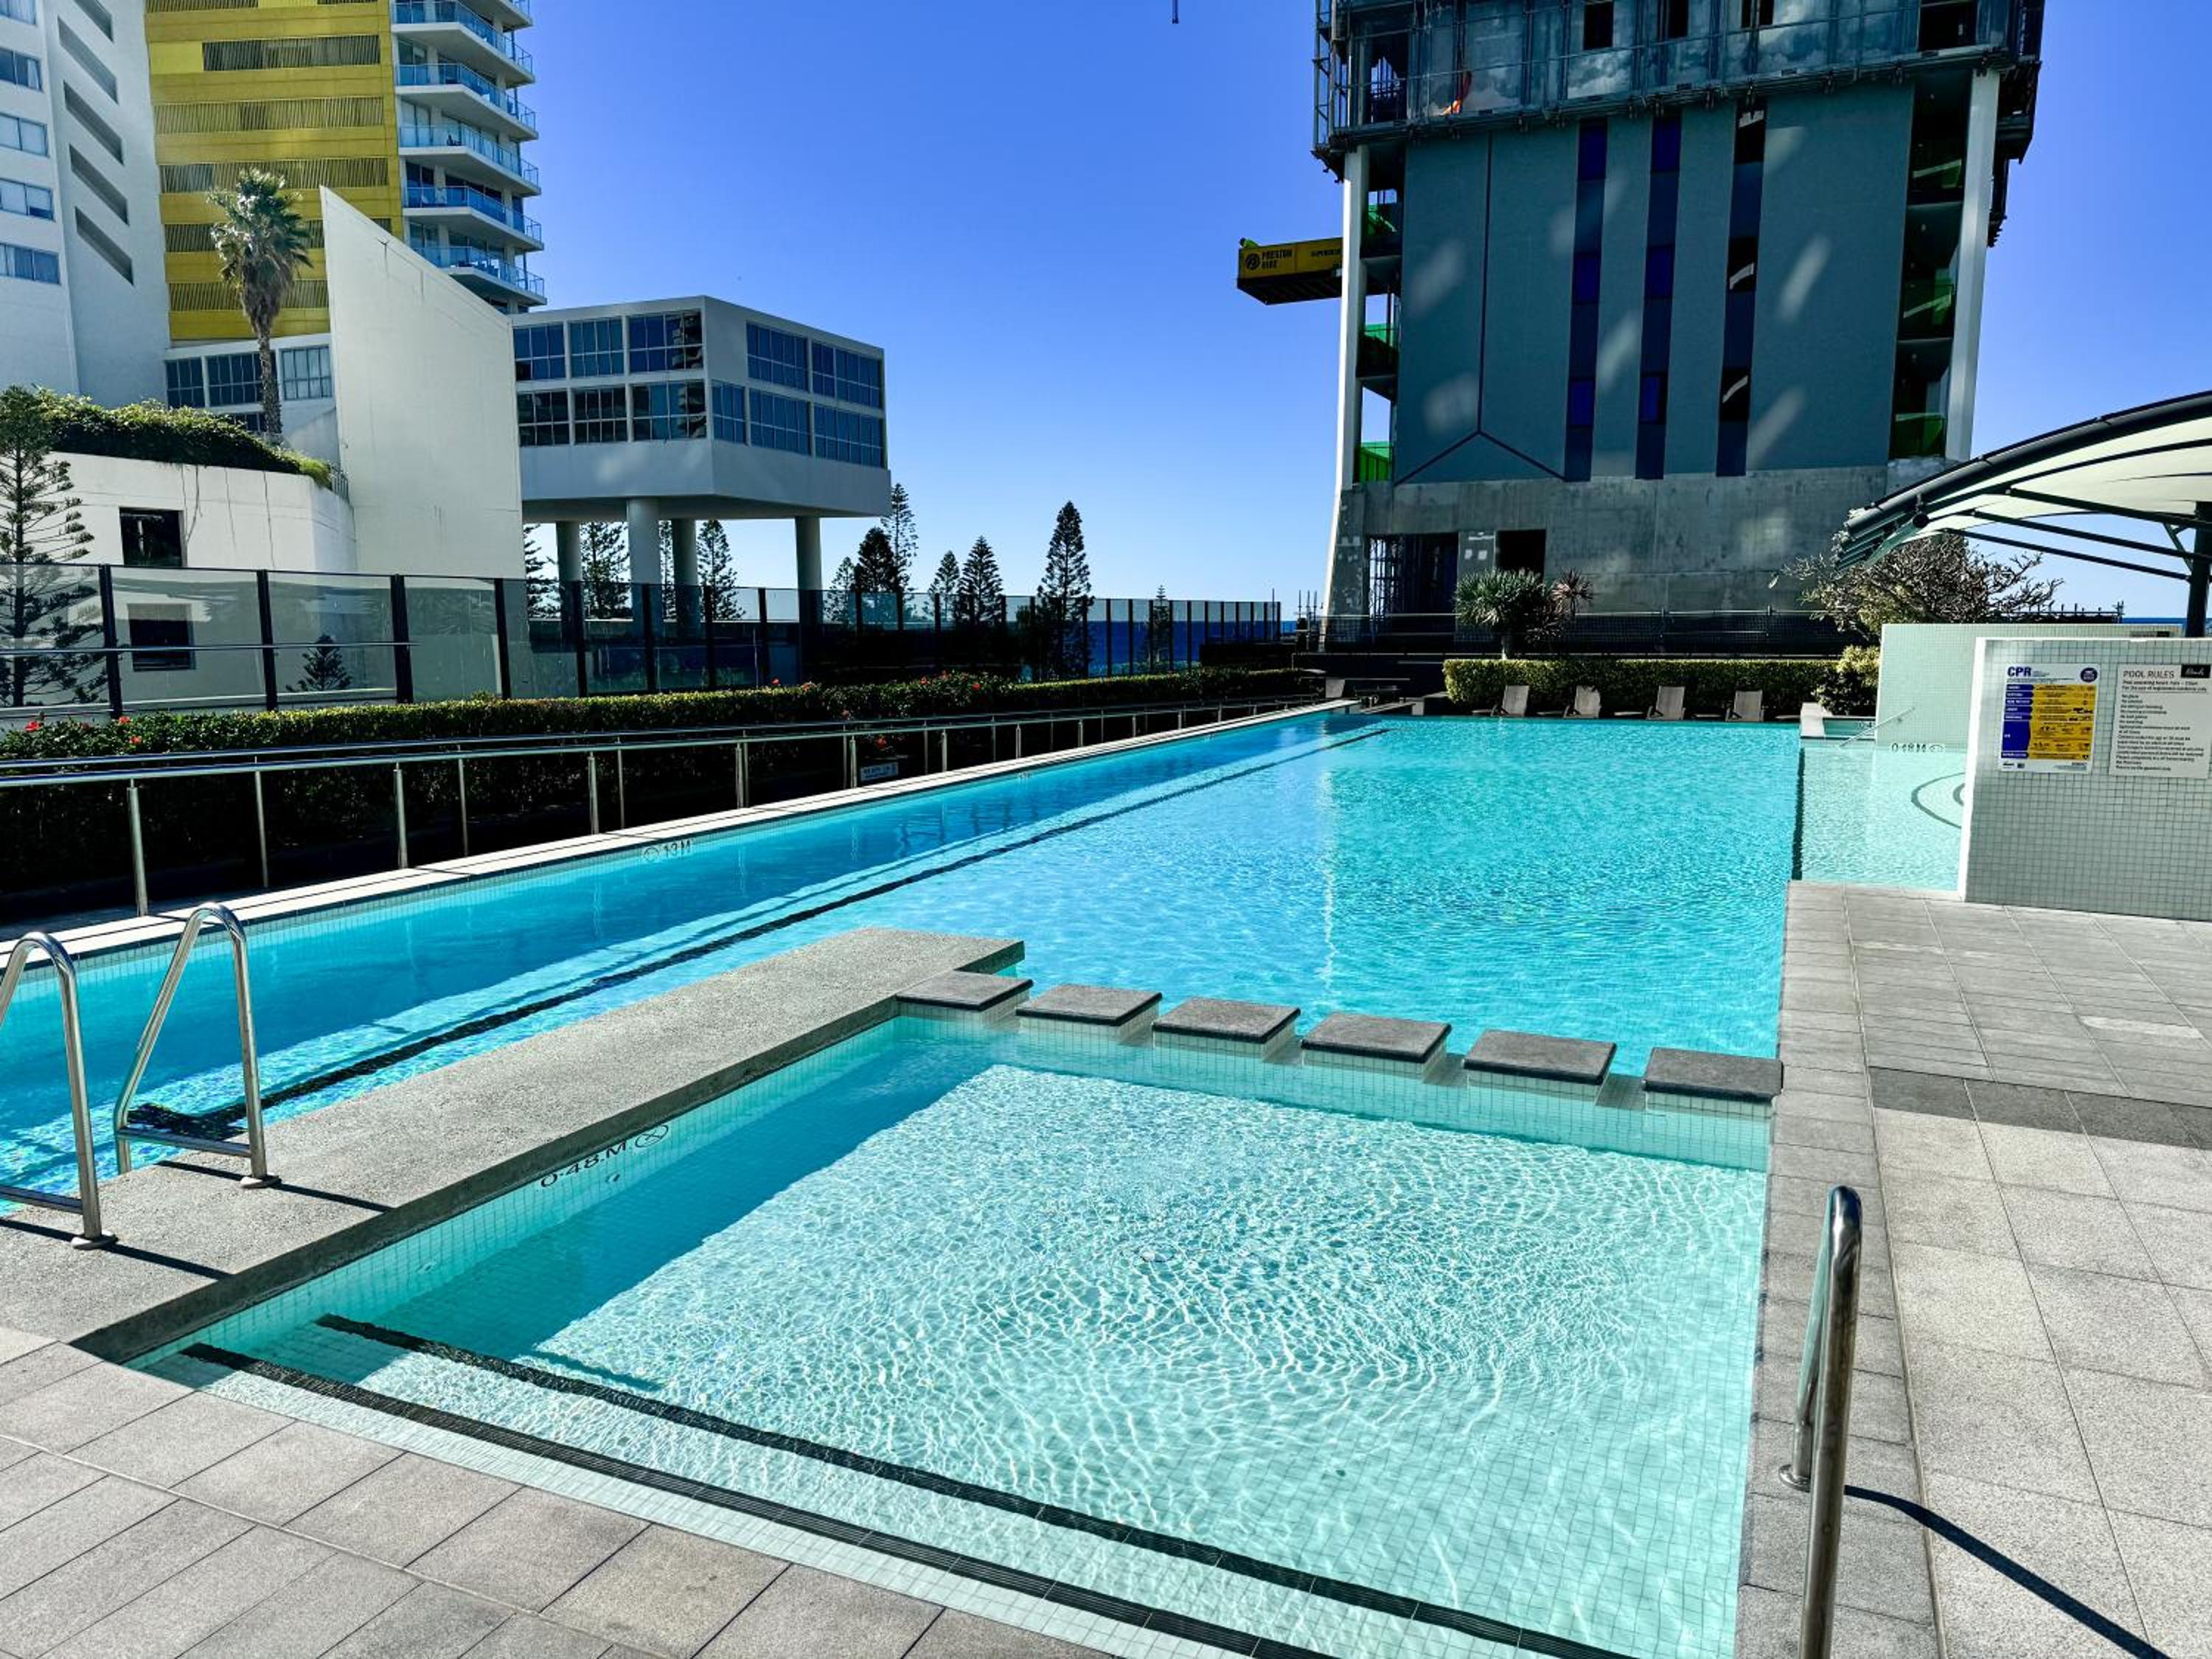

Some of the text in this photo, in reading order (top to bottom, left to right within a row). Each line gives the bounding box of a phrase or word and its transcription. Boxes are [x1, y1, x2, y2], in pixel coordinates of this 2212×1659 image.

[1262, 248, 1292, 260] PRESTON
[2007, 666, 2032, 677] CPR
[2148, 670, 2174, 678] RULES
